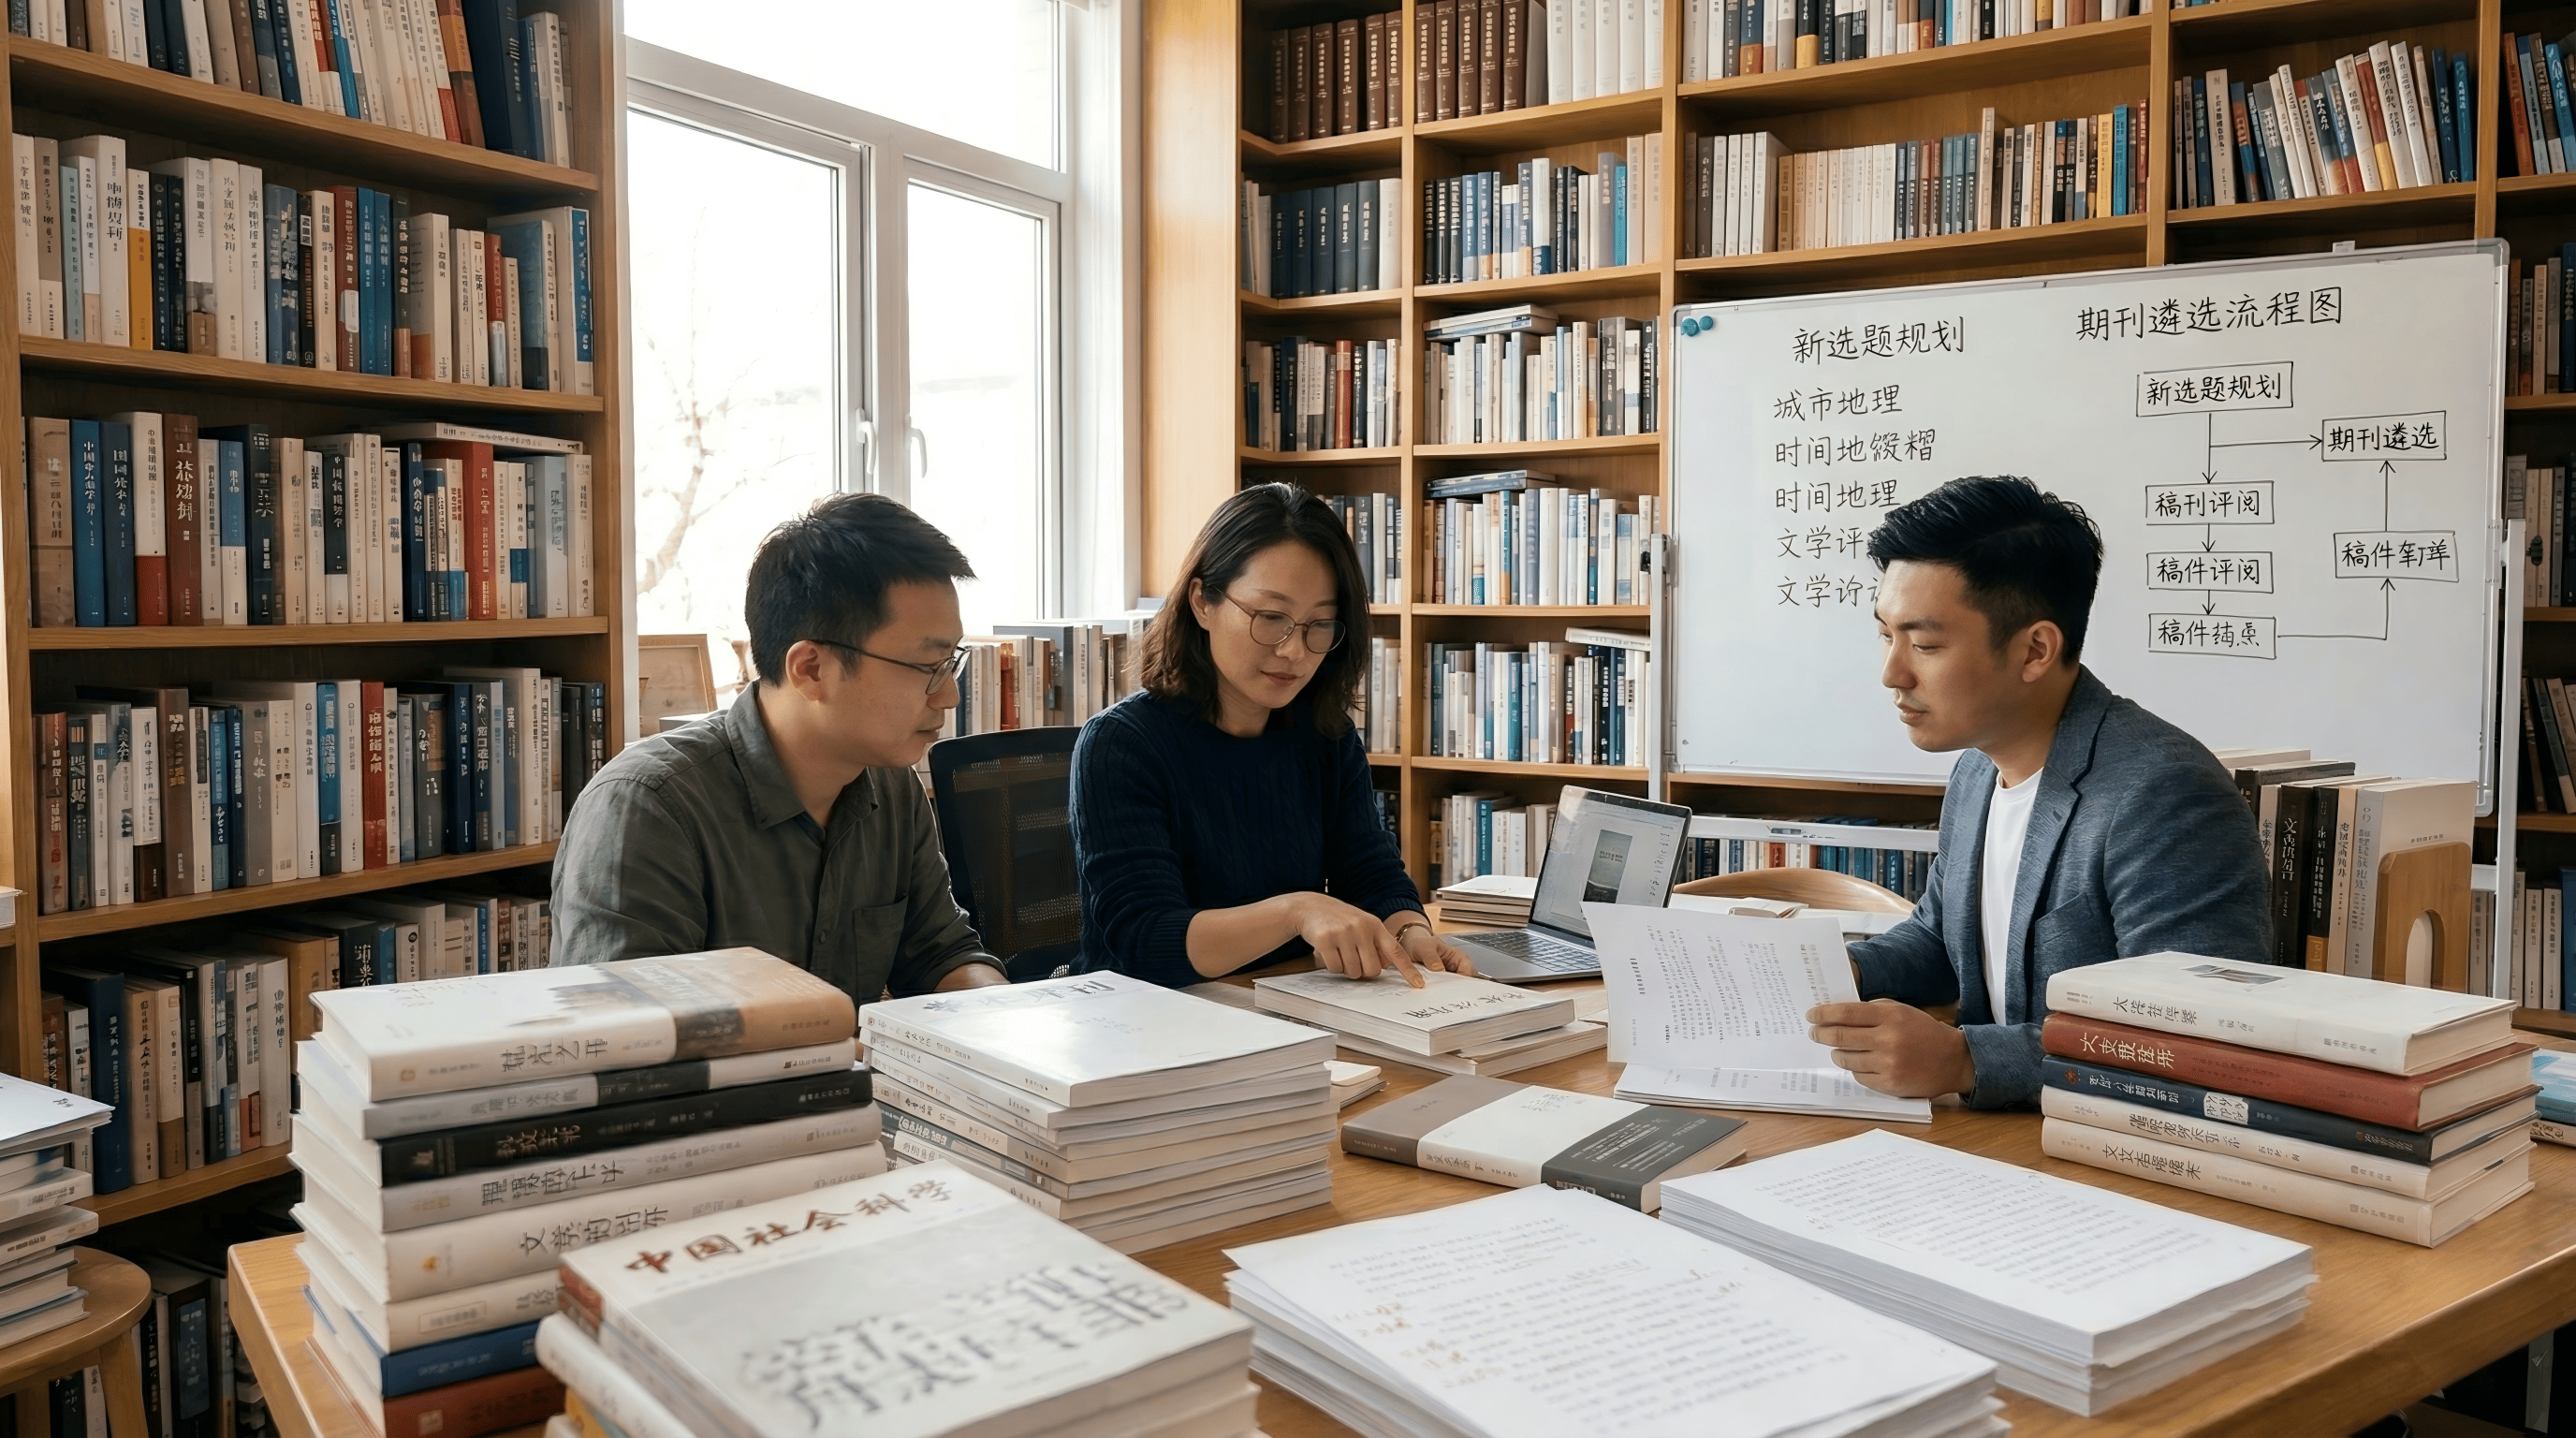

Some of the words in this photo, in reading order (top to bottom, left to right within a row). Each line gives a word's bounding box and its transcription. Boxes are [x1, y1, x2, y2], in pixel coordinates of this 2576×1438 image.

[2075, 286, 2342, 341] 期刊遴选流程图
[1792, 315, 1964, 365] 新选题规划
[1773, 384, 1903, 422] 城市地理
[2145, 372, 2282, 407] 新选题规划
[2327, 421, 2440, 453] 期刊遴选
[1776, 478, 1901, 514] 时间地理
[2154, 490, 2260, 519] 稿刊评阅
[2156, 556, 2260, 585] 稿件评阅
[624, 1179, 951, 1274] 中国社会科学
